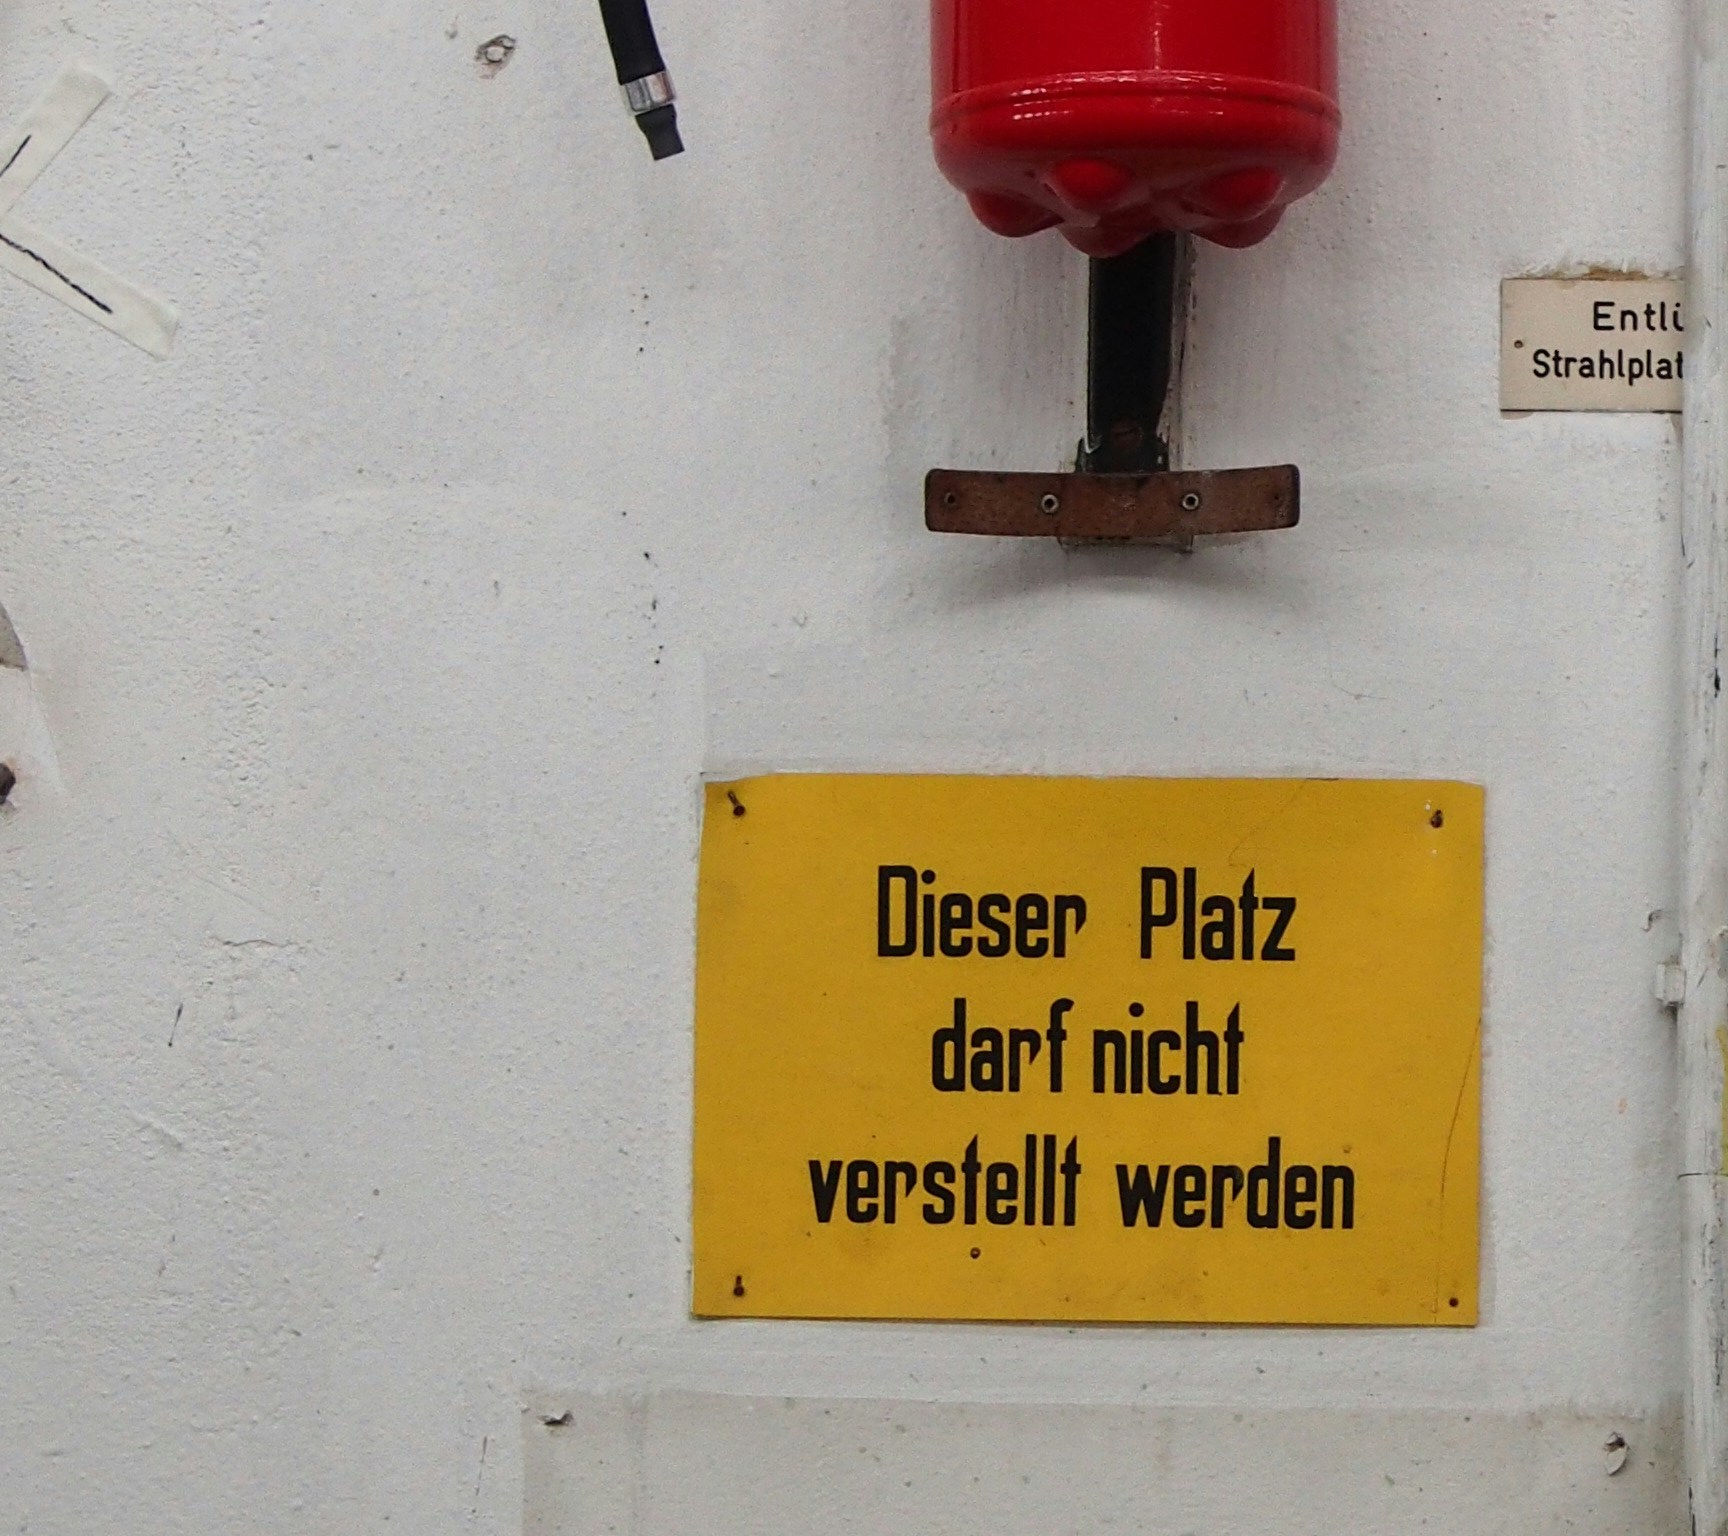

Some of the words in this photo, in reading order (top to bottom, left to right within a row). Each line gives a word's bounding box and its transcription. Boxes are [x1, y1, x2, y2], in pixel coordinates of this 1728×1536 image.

[877, 864, 1087, 959] Dieser
[1141, 866, 1297, 962] Platz
[931, 997, 1074, 1093] darf
[1093, 1000, 1245, 1096] nicht
[808, 1133, 1082, 1227] verstellt
[1116, 1136, 1355, 1230] werden
